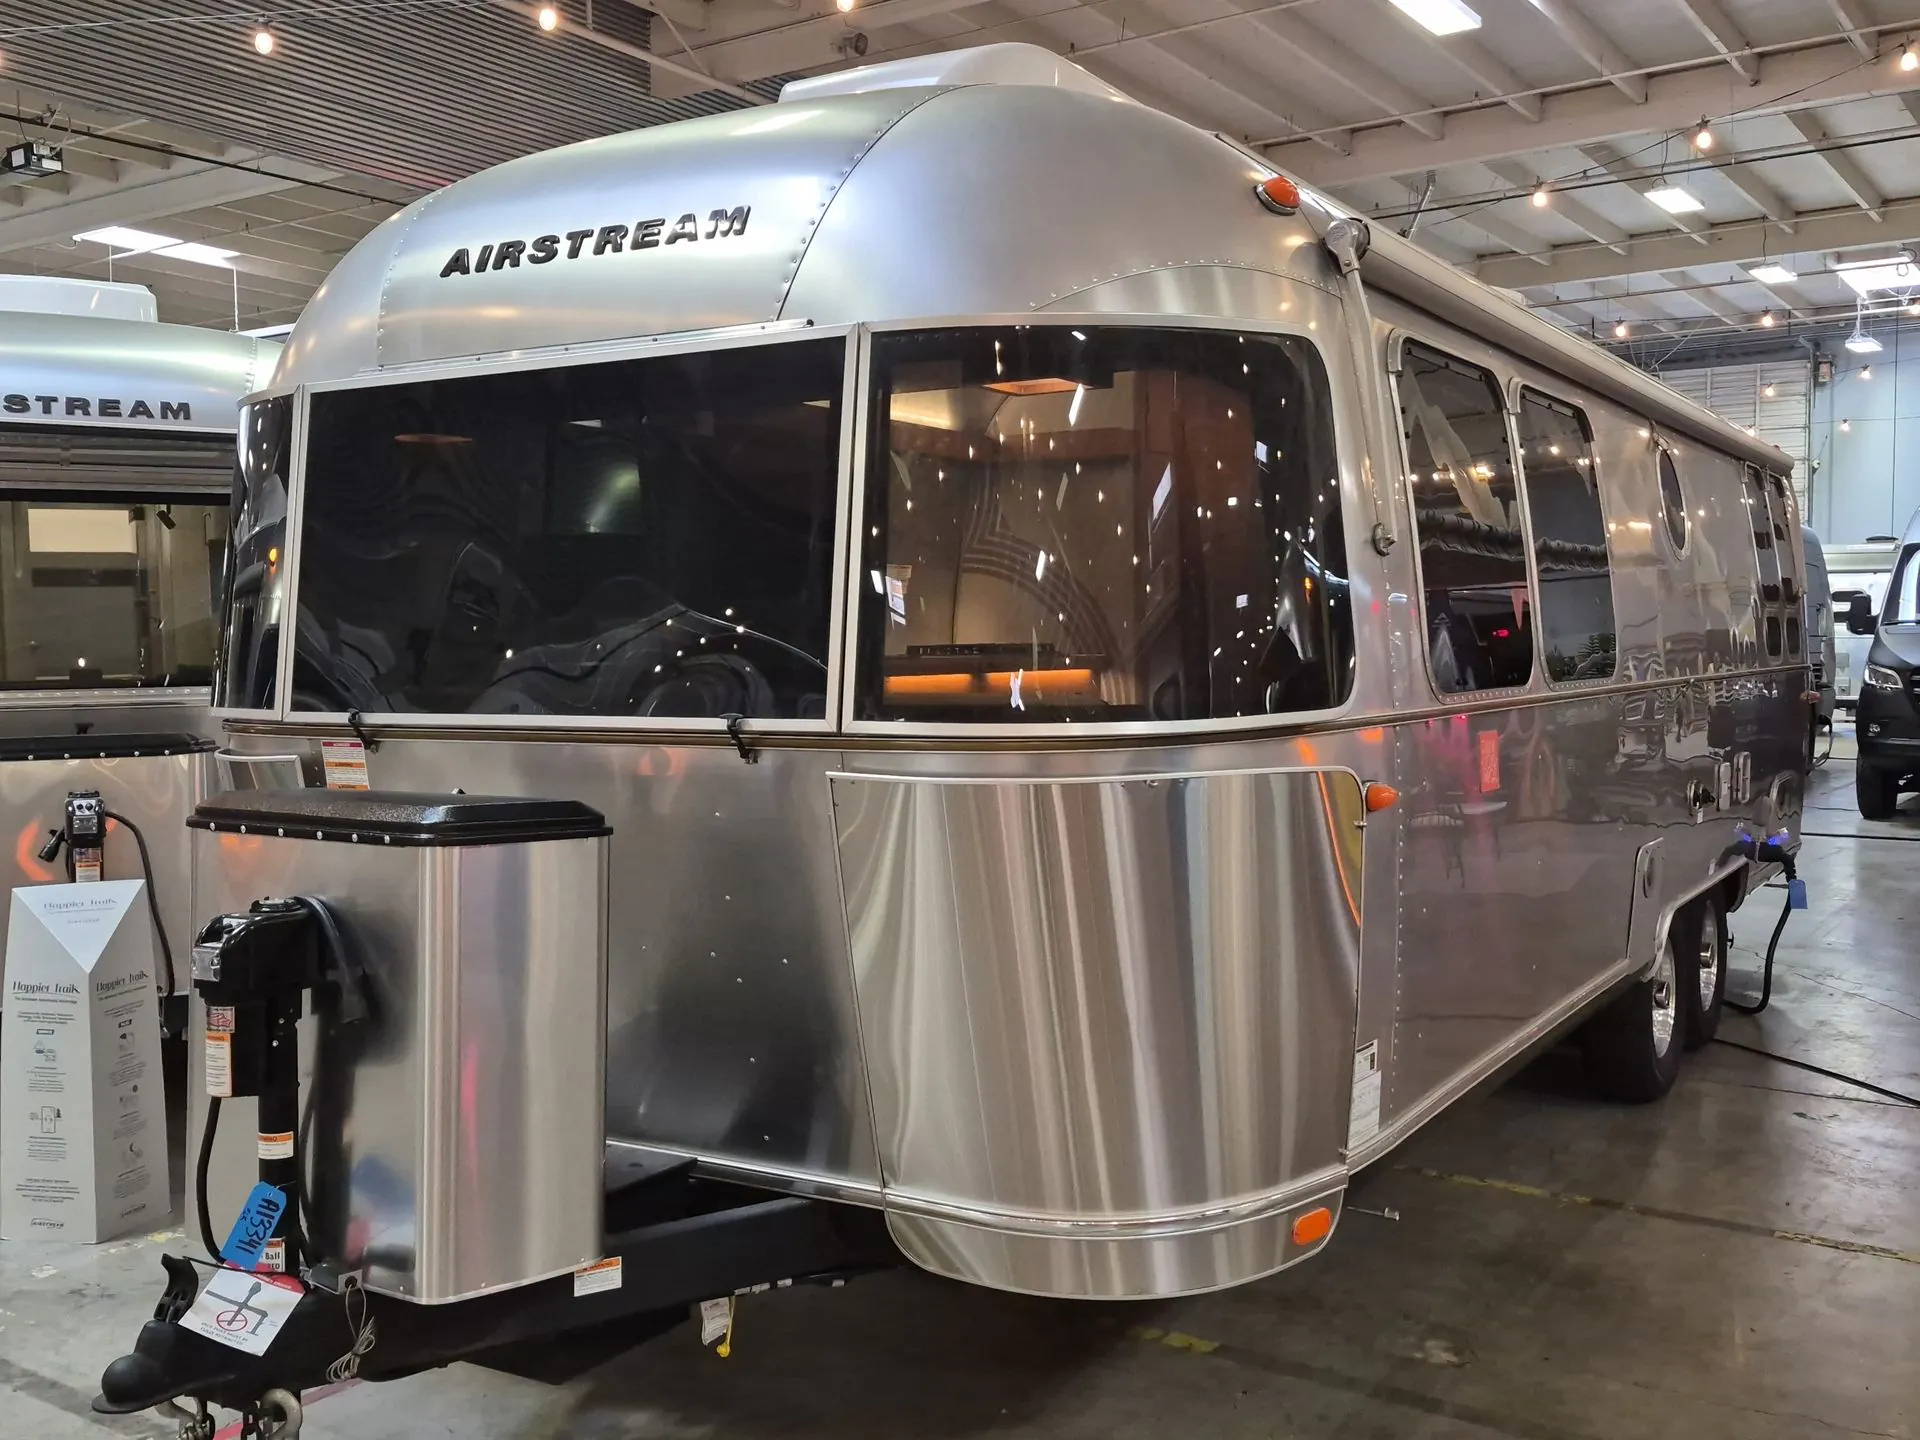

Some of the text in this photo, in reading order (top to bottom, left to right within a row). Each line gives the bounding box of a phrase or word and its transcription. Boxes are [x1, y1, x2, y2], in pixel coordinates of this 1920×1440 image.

[439, 204, 752, 278] AIRSTREAM
[3, 393, 192, 421] STREAM
[12, 981, 50, 994] Happier
[235, 1198, 280, 1256] A13341
[265, 1252, 280, 1260] Ball
